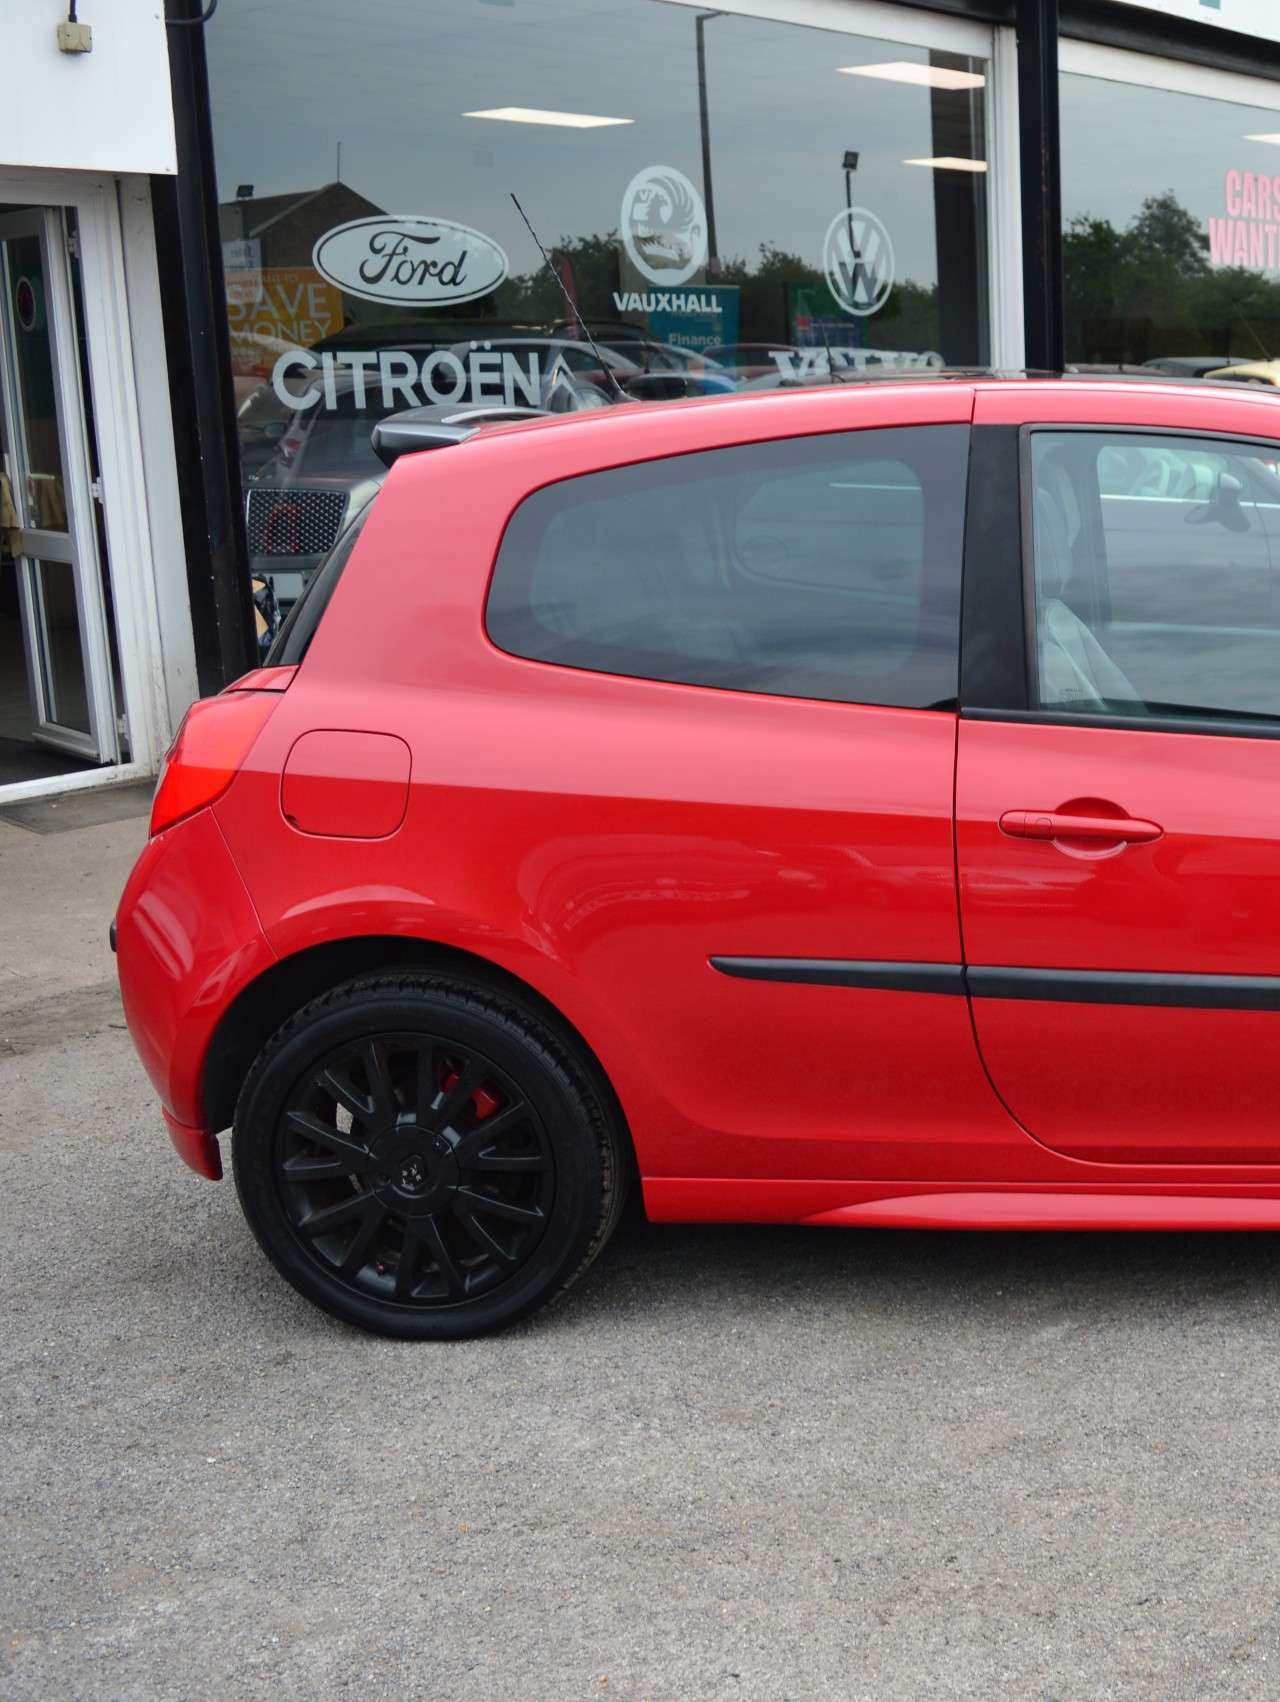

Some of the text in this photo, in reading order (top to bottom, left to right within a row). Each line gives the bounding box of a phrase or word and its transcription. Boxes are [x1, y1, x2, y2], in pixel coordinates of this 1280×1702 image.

[359, 231, 468, 287] Ford
[612, 292, 722, 313] VAUXHALL
[668, 333, 722, 346] Finance
